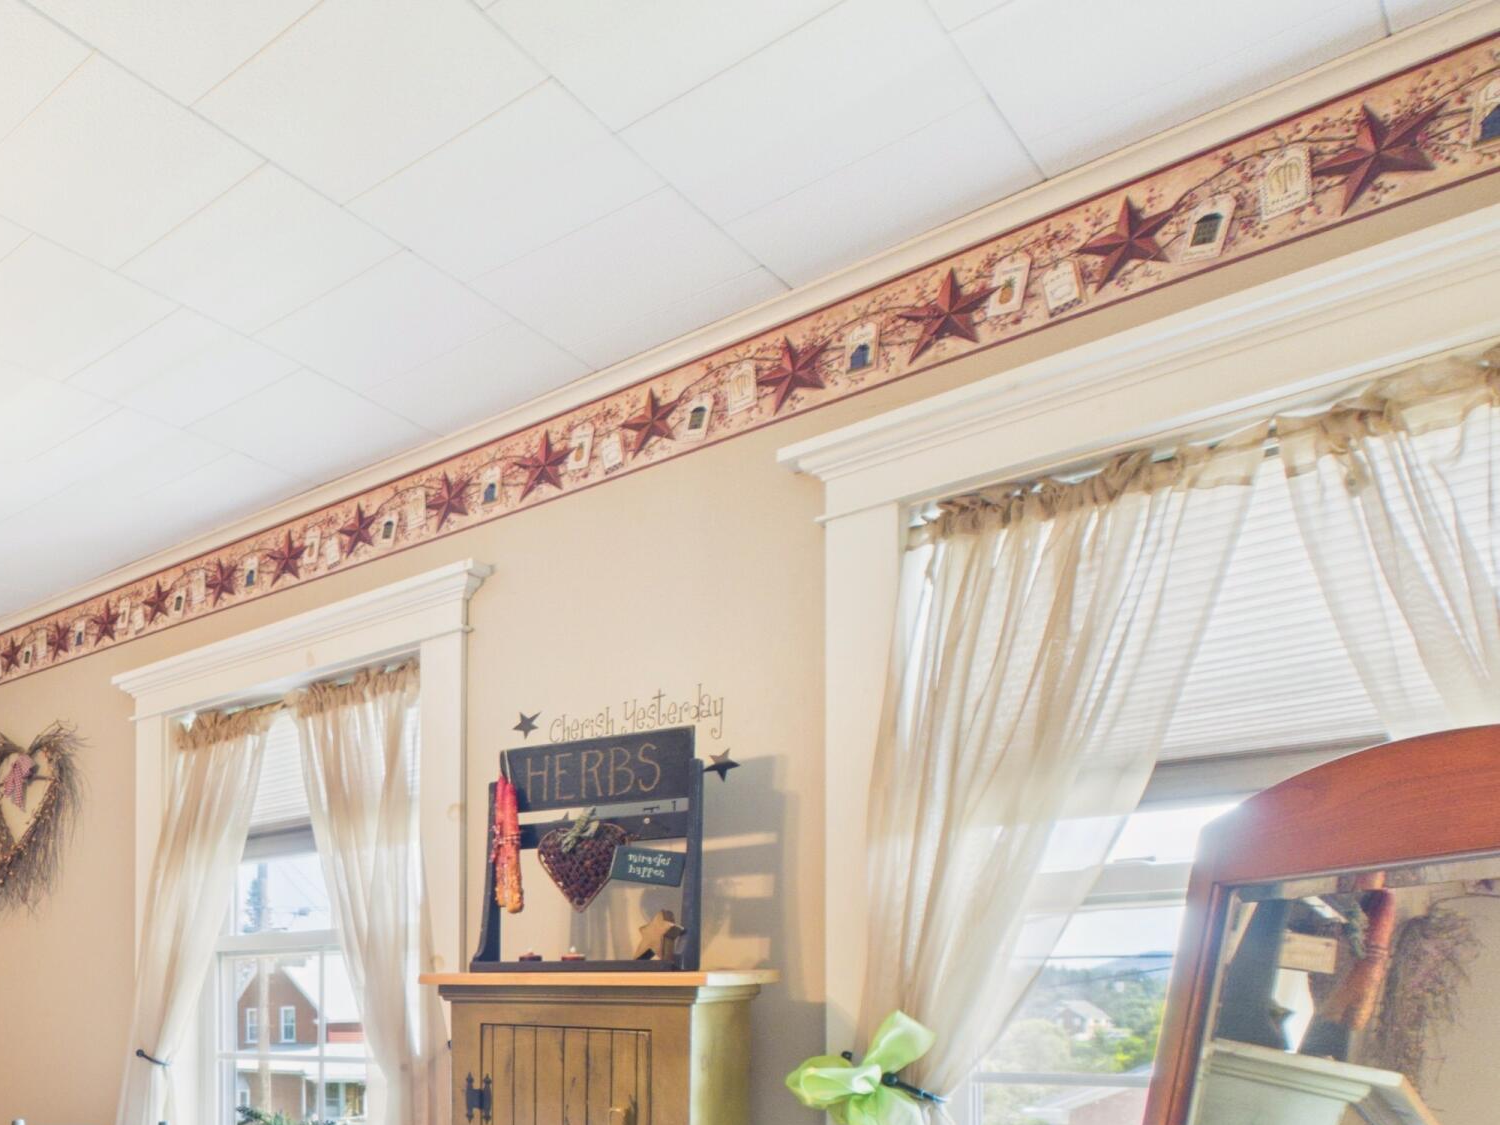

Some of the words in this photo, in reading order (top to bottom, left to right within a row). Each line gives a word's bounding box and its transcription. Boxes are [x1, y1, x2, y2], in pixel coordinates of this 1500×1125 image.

[550, 706, 614, 744] Cherish
[620, 683, 724, 740] Yesterday
[526, 742, 661, 803] HERBS
[628, 853, 672, 867] miracles
[628, 864, 666, 879] happen
